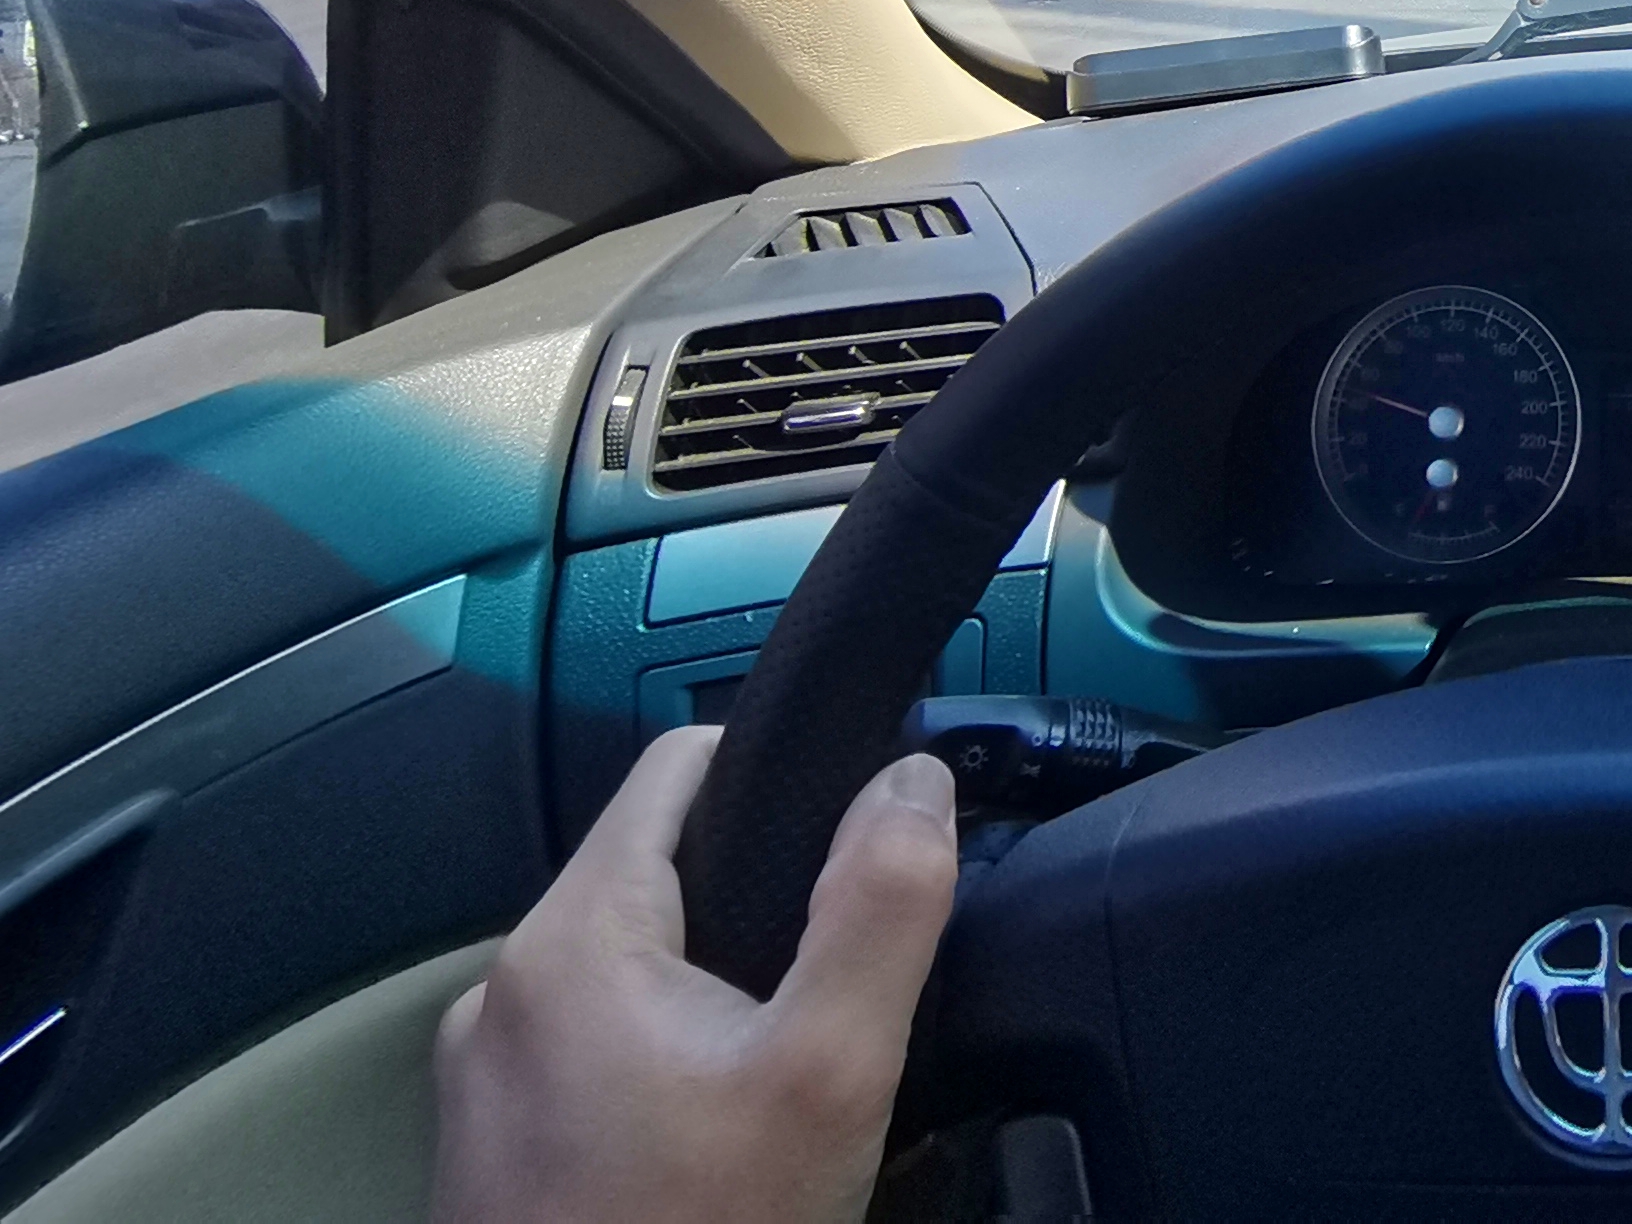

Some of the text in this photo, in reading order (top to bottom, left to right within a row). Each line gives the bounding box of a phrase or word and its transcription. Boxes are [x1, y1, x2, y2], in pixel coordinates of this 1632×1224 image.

[1521, 402, 1547, 414] 200
[1519, 435, 1547, 448] 220
[1505, 467, 1533, 479] 240
